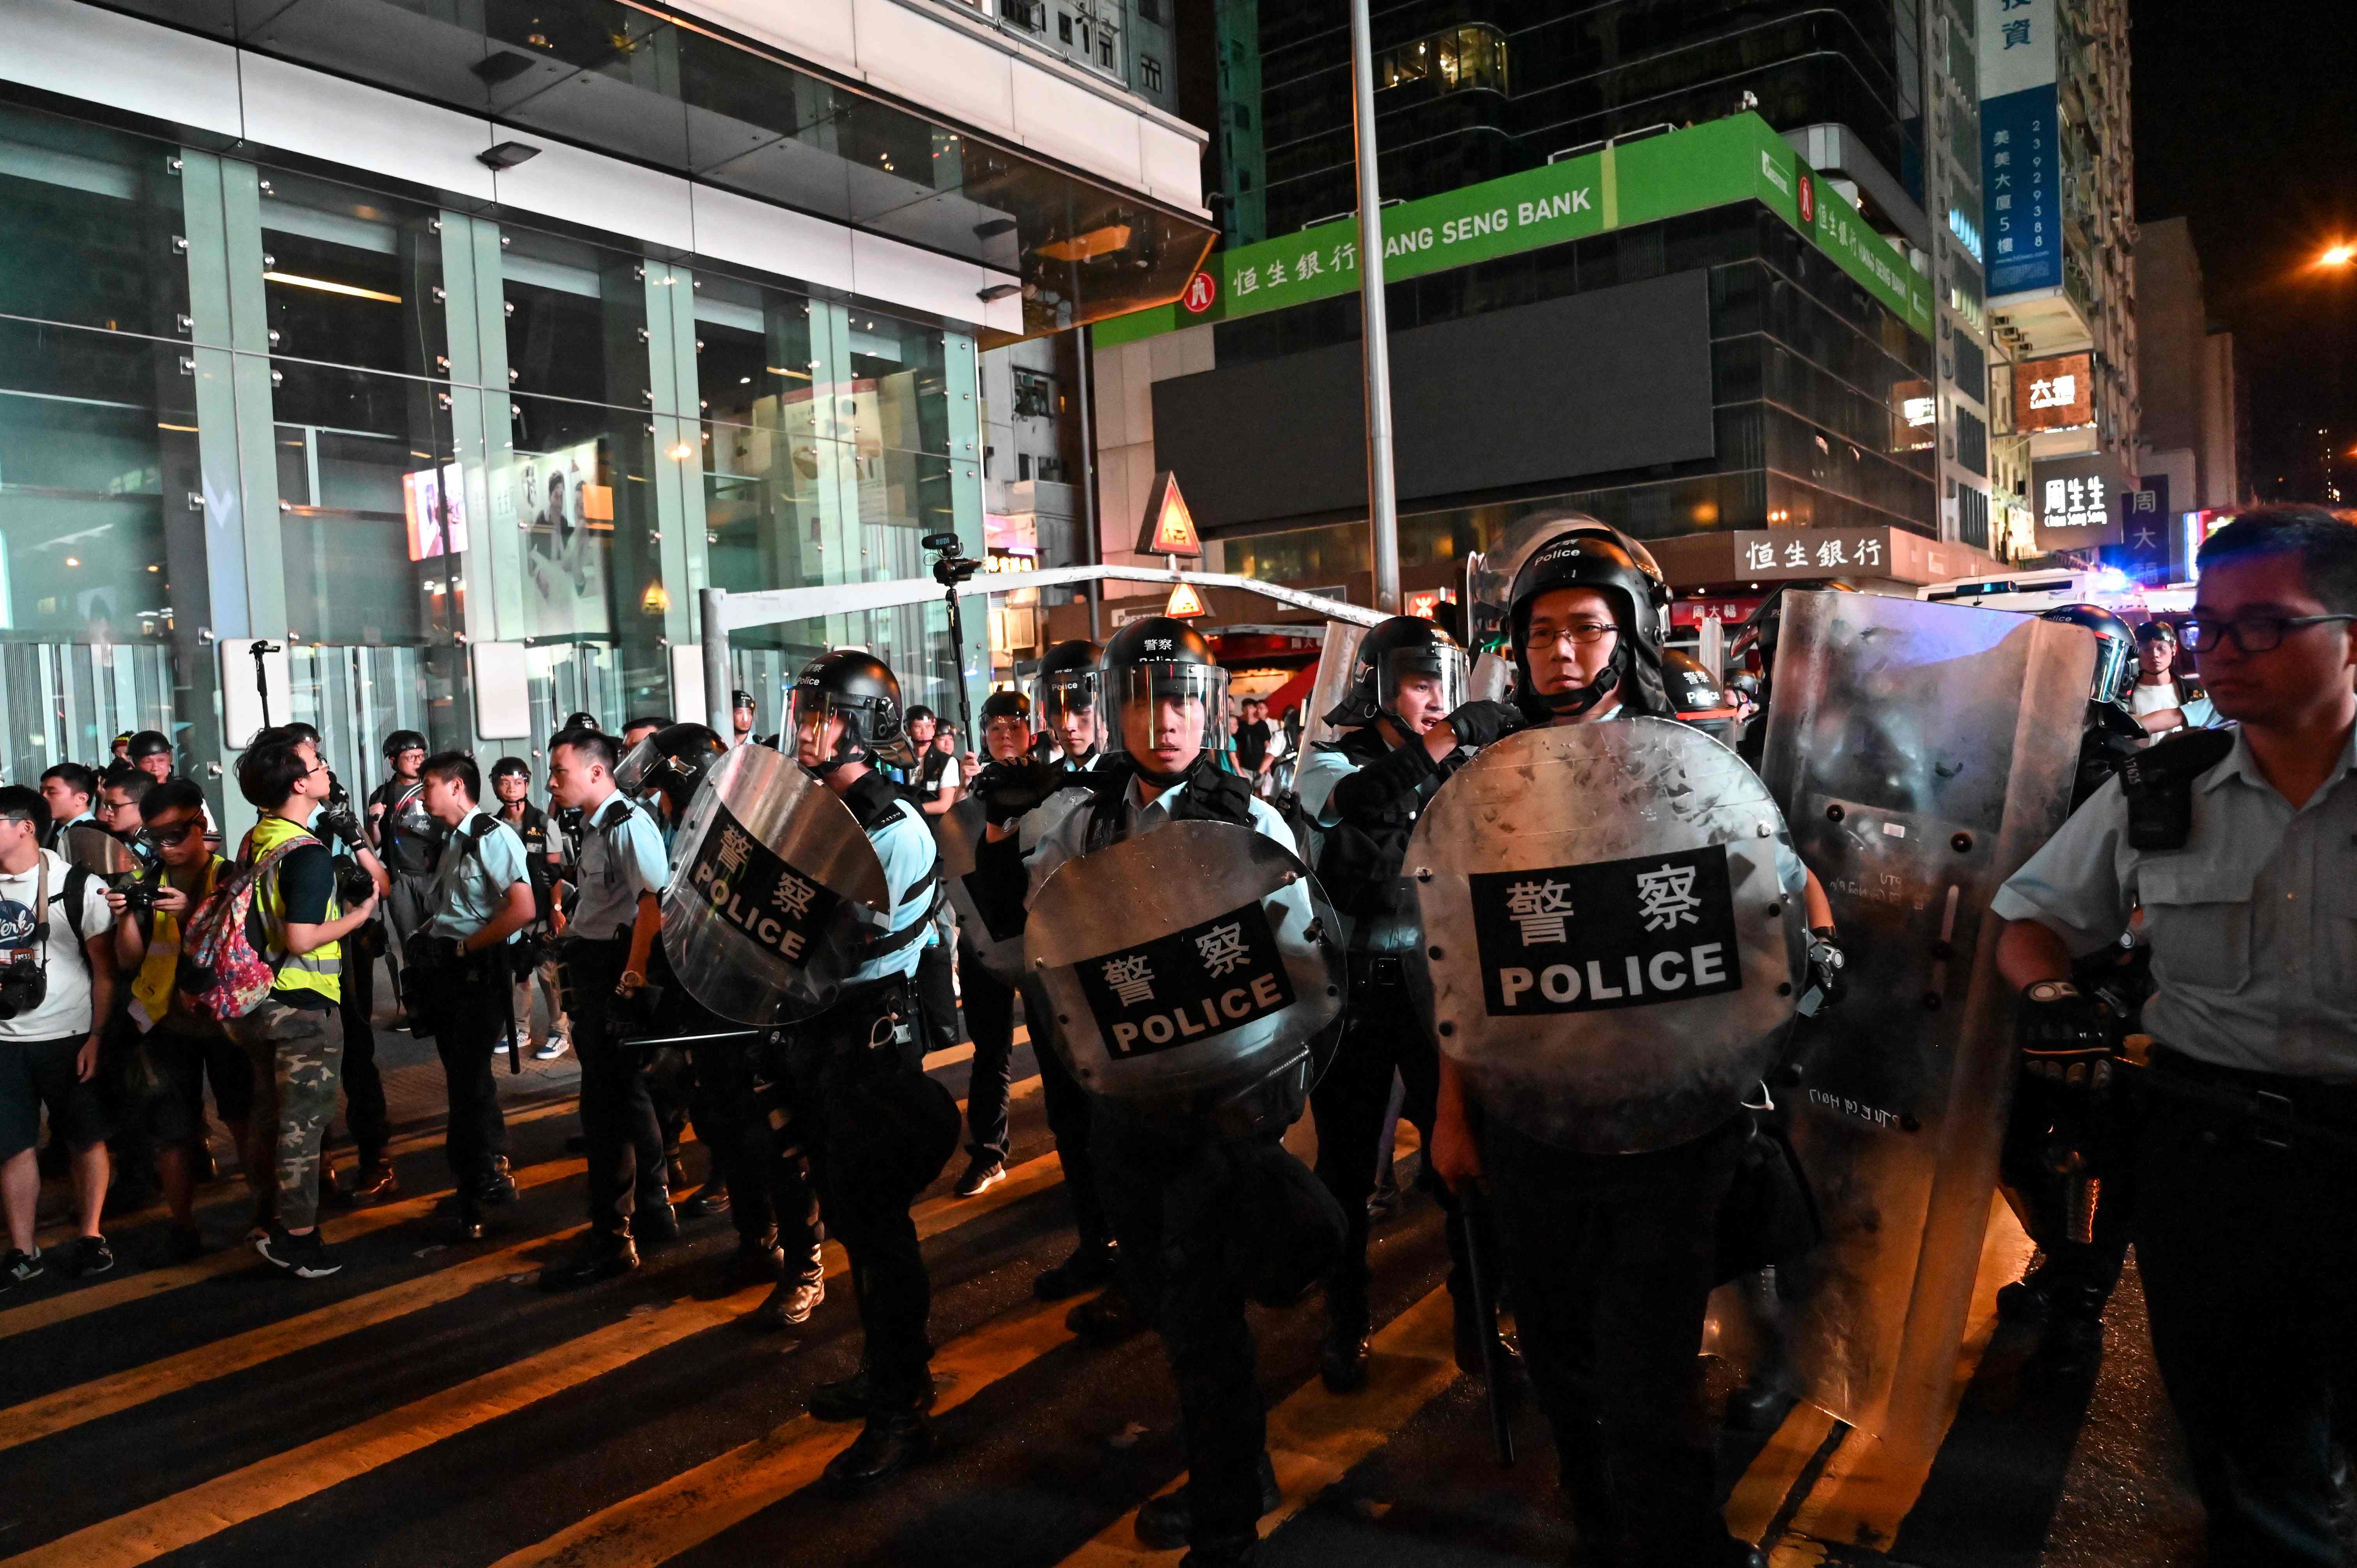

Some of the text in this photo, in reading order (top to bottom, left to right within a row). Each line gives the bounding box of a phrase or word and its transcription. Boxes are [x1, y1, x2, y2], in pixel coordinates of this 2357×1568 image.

[2032, 120, 2044, 248] 23929388
[1383, 187, 1590, 259] ANG SENG BANK
[1233, 243, 1355, 296] 恒生銀行
[2044, 475, 2105, 514] 周生生
[1535, 549, 1580, 566] Police
[1746, 539, 1881, 570] 恒生銀行
[1144, 638, 1172, 651] 警察
[1052, 681, 1078, 691] Police
[718, 823, 816, 920] 警察
[694, 860, 806, 959] POLICE
[1506, 863, 1701, 946] 警察
[15, 953, 31, 961] PRESS
[1102, 922, 1251, 1006] 警察
[1500, 942, 1726, 1006] POLICE
[1112, 973, 1283, 1051] POLICE
